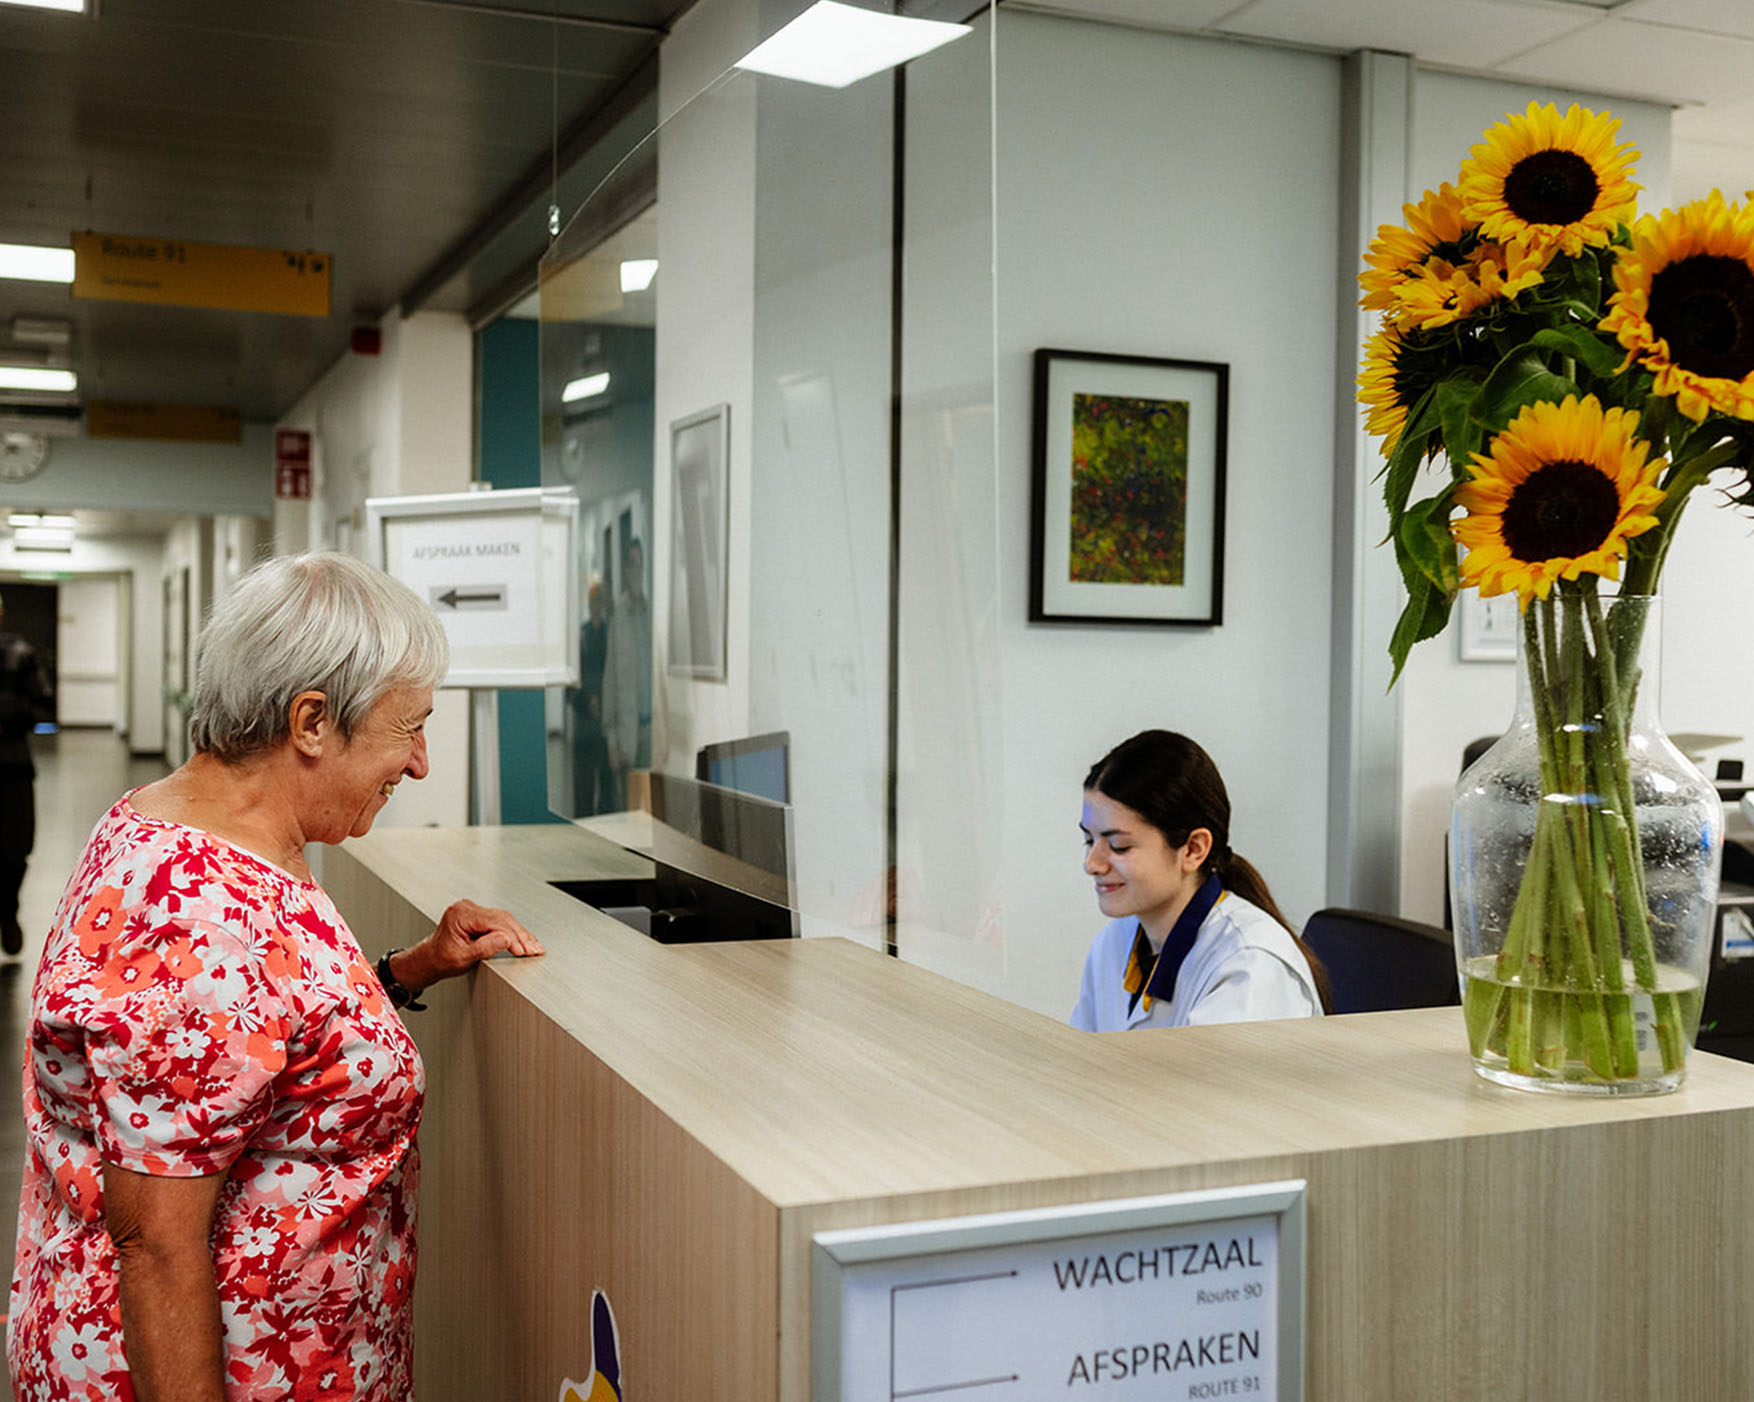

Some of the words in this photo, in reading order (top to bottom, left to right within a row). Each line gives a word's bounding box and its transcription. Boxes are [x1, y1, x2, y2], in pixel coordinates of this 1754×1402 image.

[102, 237, 157, 259] Route
[163, 242, 186, 264] 91
[412, 545, 472, 560] AFSPRAAK
[475, 543, 521, 557] MAKEN
[1053, 1237, 1263, 1291] WACHTZAAL
[1197, 1289, 1240, 1305] Route
[1243, 1282, 1263, 1298] 90
[1068, 1329, 1260, 1387] AFSPRAKEN
[1188, 1380, 1239, 1400] ROUTE
[1243, 1376, 1261, 1392] 91
